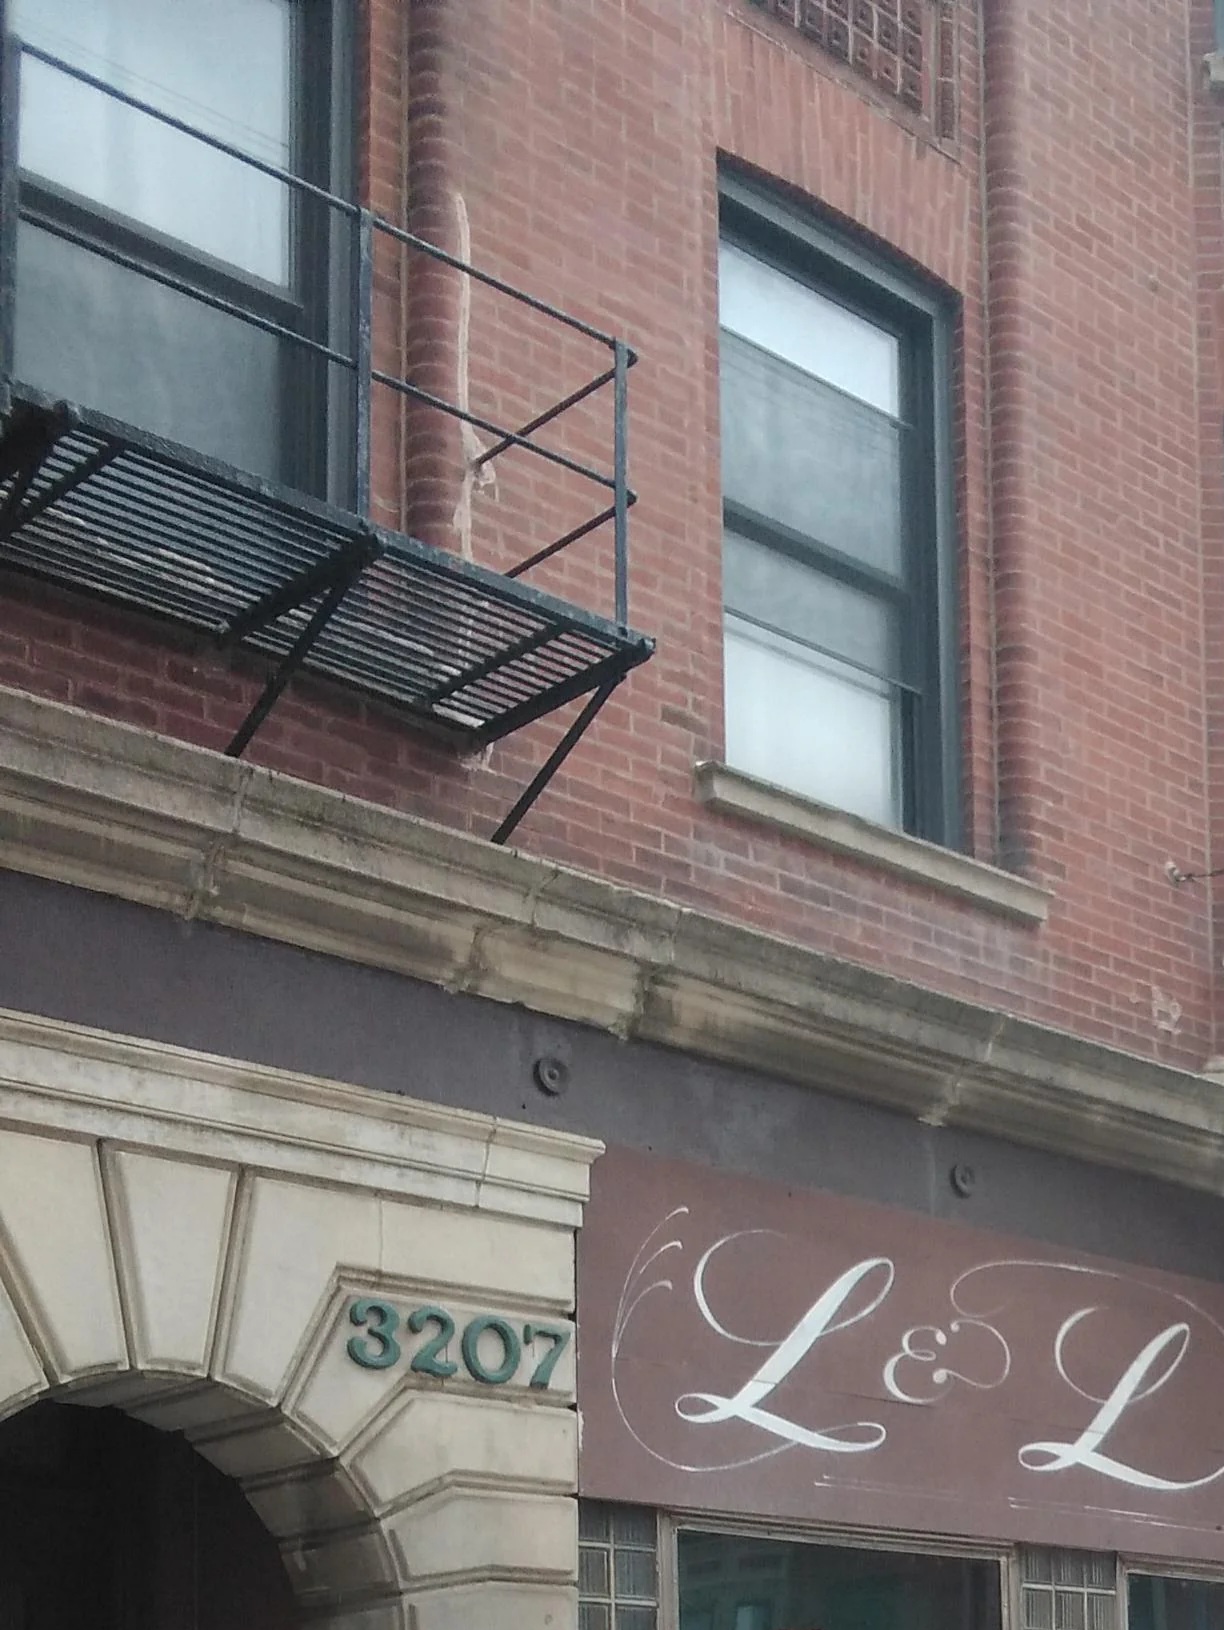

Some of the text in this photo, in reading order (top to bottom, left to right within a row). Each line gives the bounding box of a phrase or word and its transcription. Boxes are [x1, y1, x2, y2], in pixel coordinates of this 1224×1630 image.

[347, 1299, 571, 1389] 3207
[675, 1228, 894, 1454] L
[883, 1318, 1010, 1404] &
